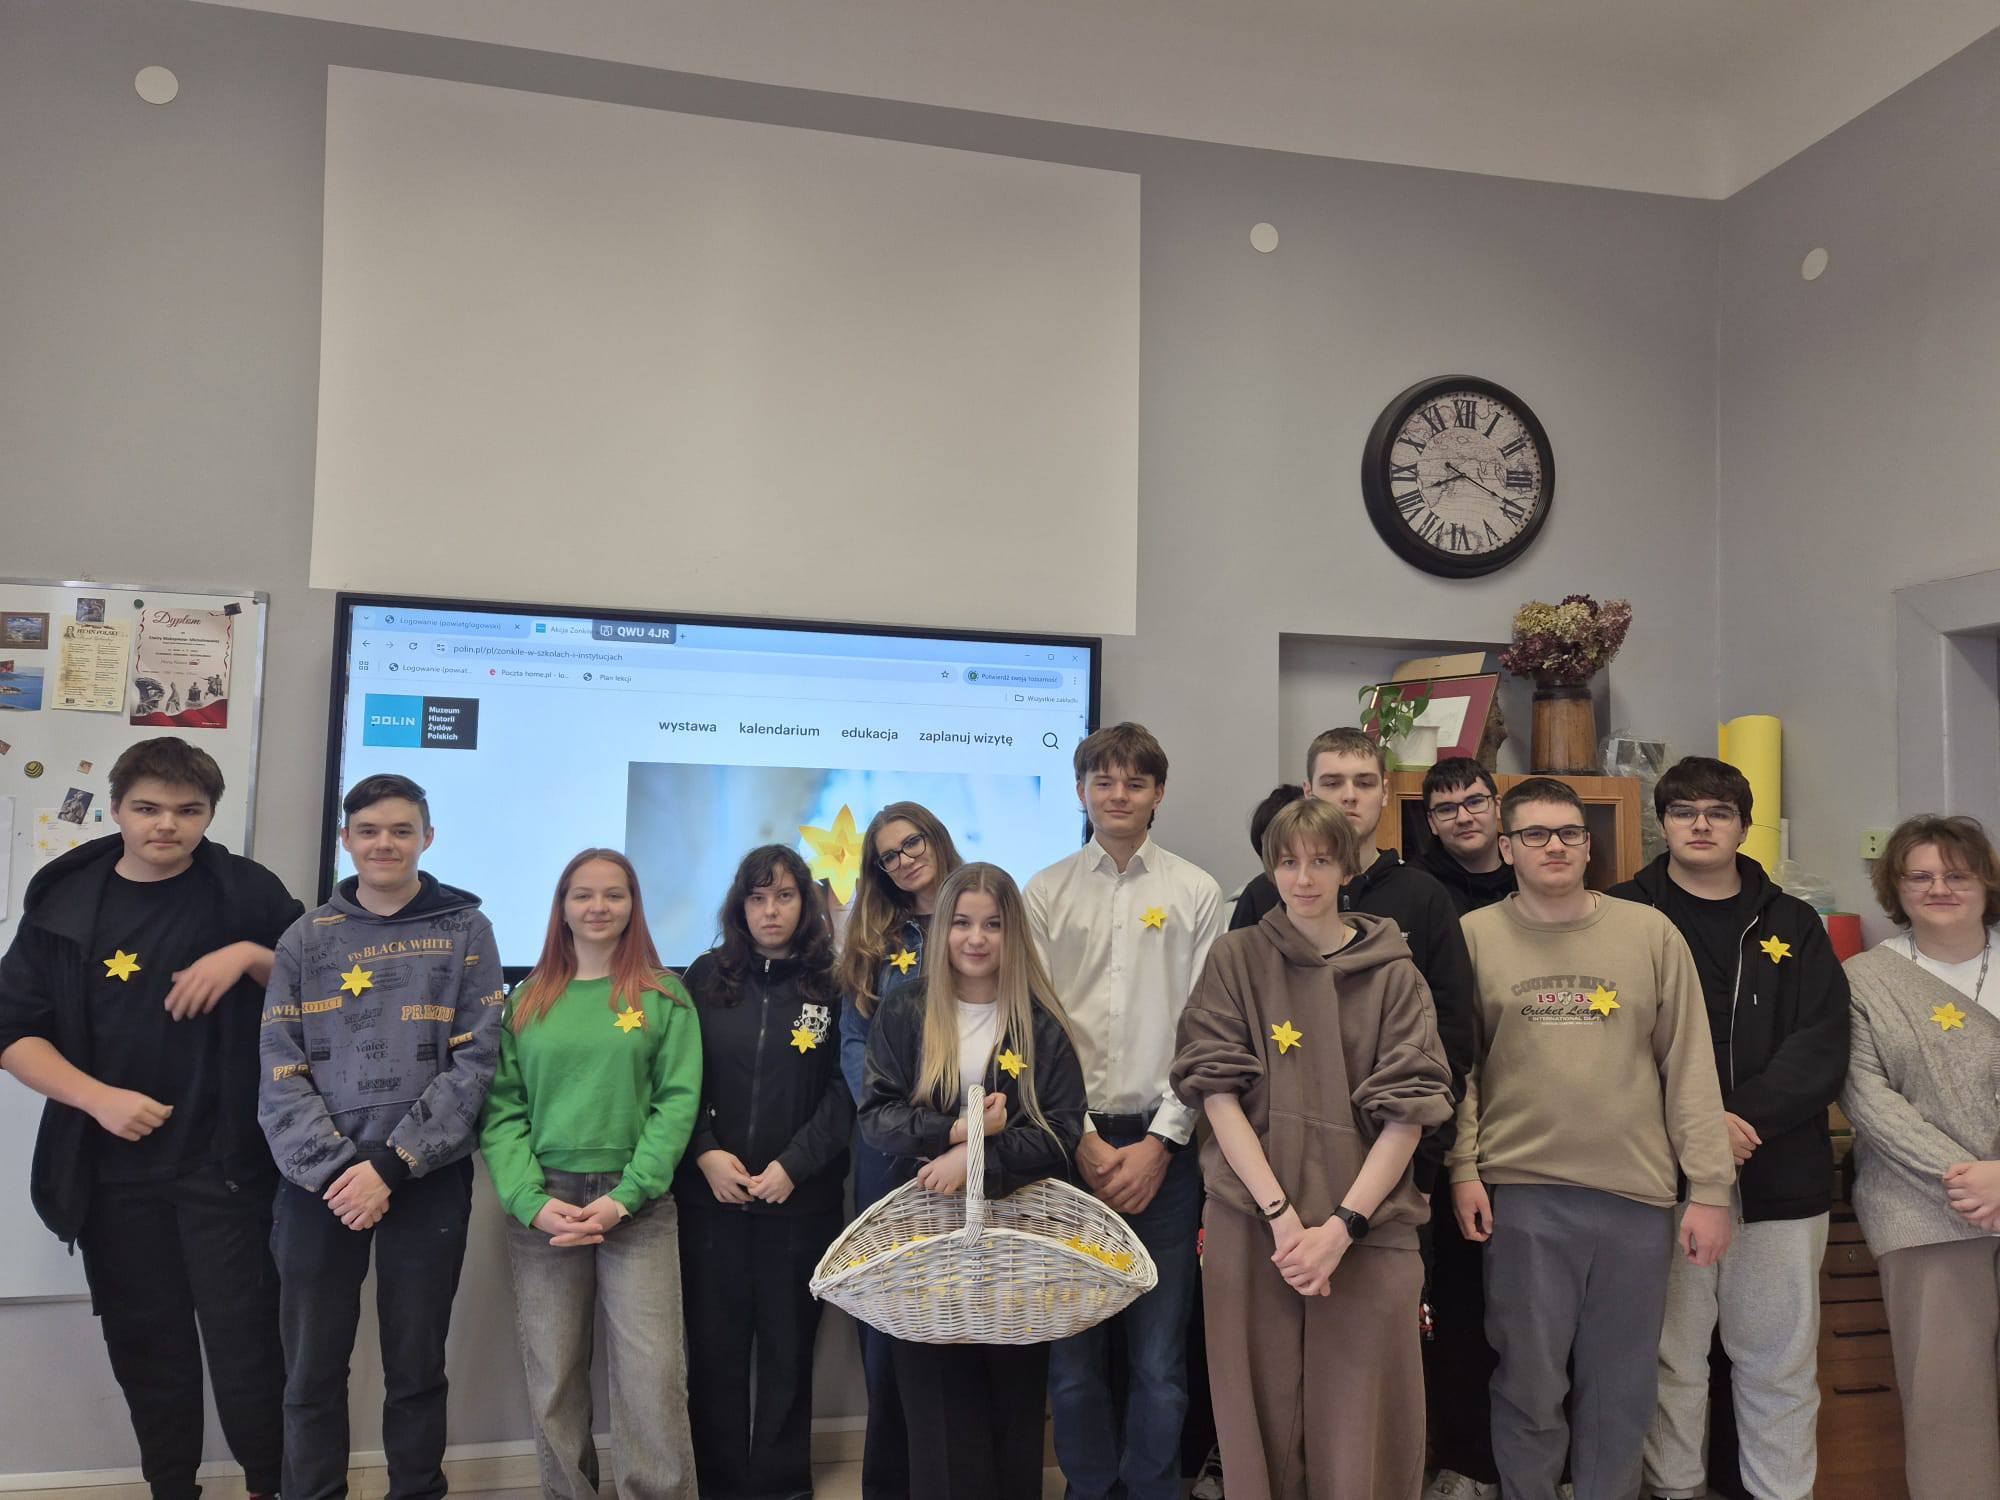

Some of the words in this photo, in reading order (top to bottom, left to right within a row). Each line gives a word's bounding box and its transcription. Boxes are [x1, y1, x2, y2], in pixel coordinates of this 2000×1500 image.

[1418, 403, 1448, 438] XI
[1452, 400, 1477, 429] XII
[1483, 412, 1503, 438] I
[1397, 430, 1426, 455] X
[1499, 436, 1527, 460] II
[1506, 469, 1532, 488] III
[1483, 519, 1502, 546] V
[153, 611, 201, 627] Dyplom
[617, 626, 644, 637] QWU
[648, 627, 670, 639] 4JR
[600, 674, 614, 682] Plan
[429, 706, 460, 715] Muzeum
[428, 715, 455, 723] Historii
[428, 723, 453, 732] Żydów
[658, 721, 717, 733] wystawa
[739, 722, 820, 737] kalendarium
[841, 727, 898, 742] edukacja
[919, 731, 970, 744] zaplanuj
[973, 734, 1013, 747] wizytę
[427, 732, 458, 741] Polskich
[410, 938, 453, 950] WHITE
[1511, 975, 1576, 996] COUNTY
[1537, 994, 1556, 1003] 19
[1521, 1005, 1564, 1016] Cricket
